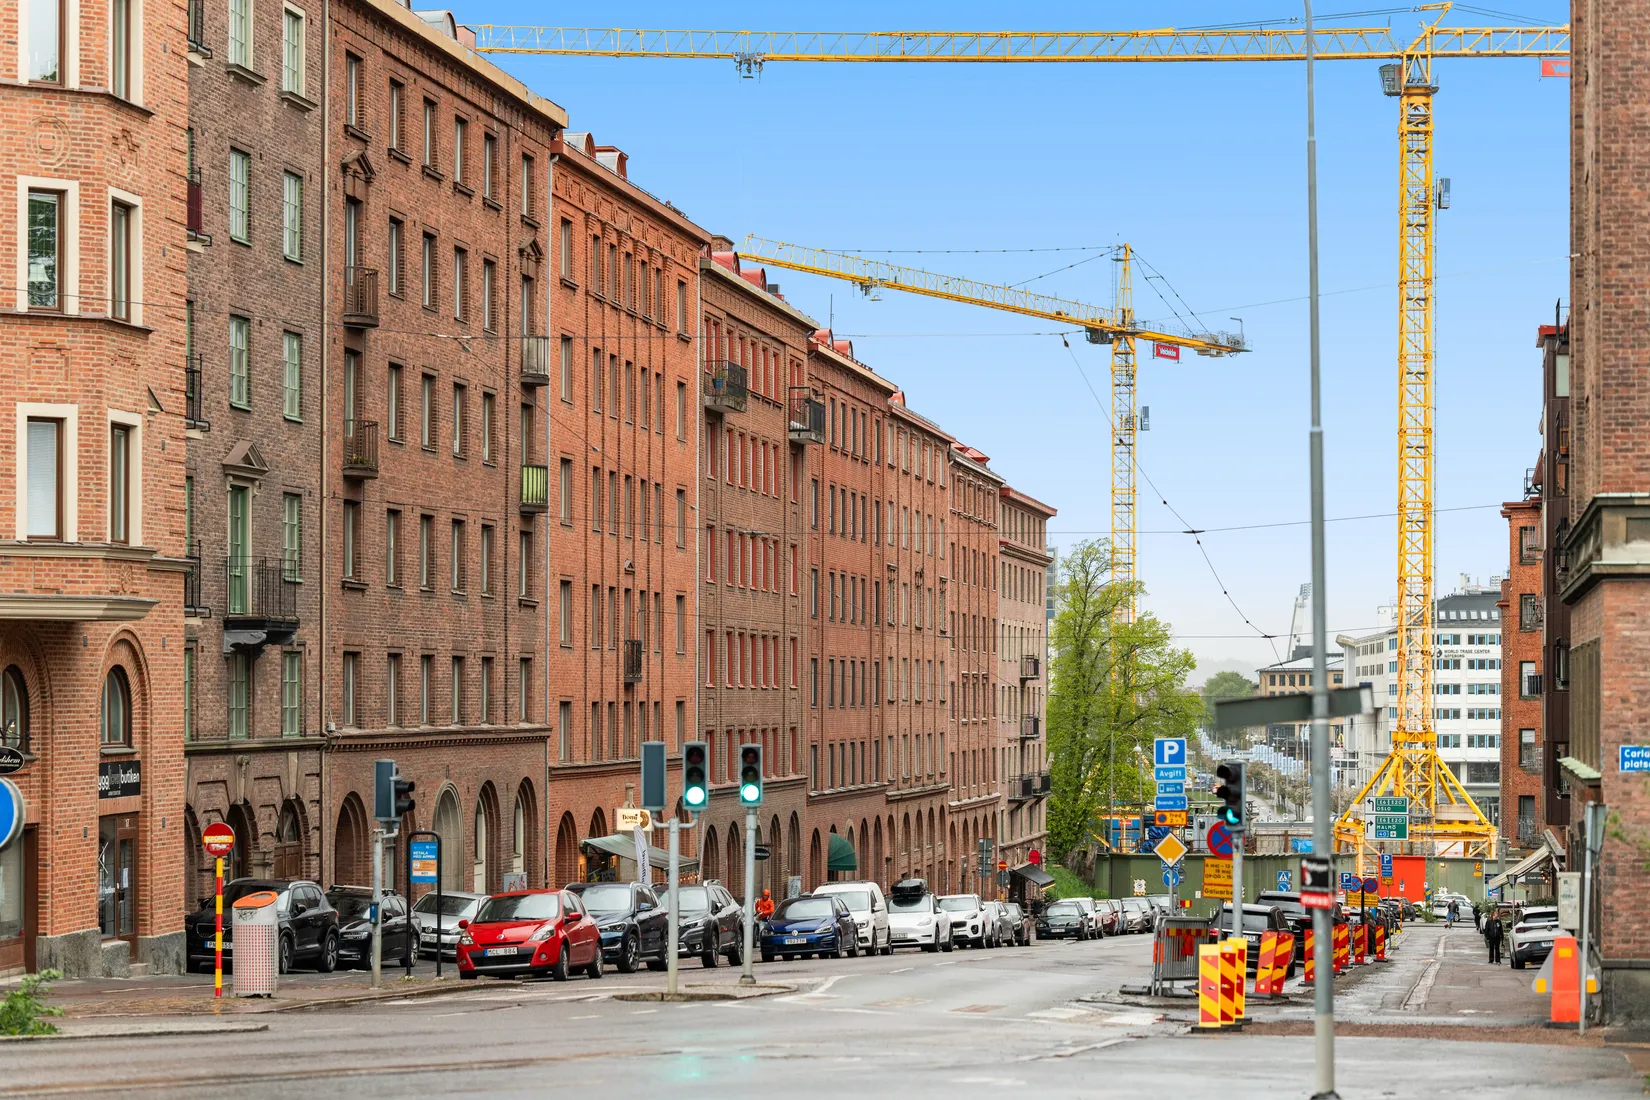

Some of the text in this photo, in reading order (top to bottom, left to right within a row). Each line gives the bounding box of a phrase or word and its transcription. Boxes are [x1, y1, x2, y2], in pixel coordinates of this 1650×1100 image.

[1163, 741, 1180, 764] P
[1624, 760, 1650, 770] plats
[1159, 770, 1182, 779] Avgift
[1384, 855, 1390, 864] P
[1343, 874, 1350, 883] P
